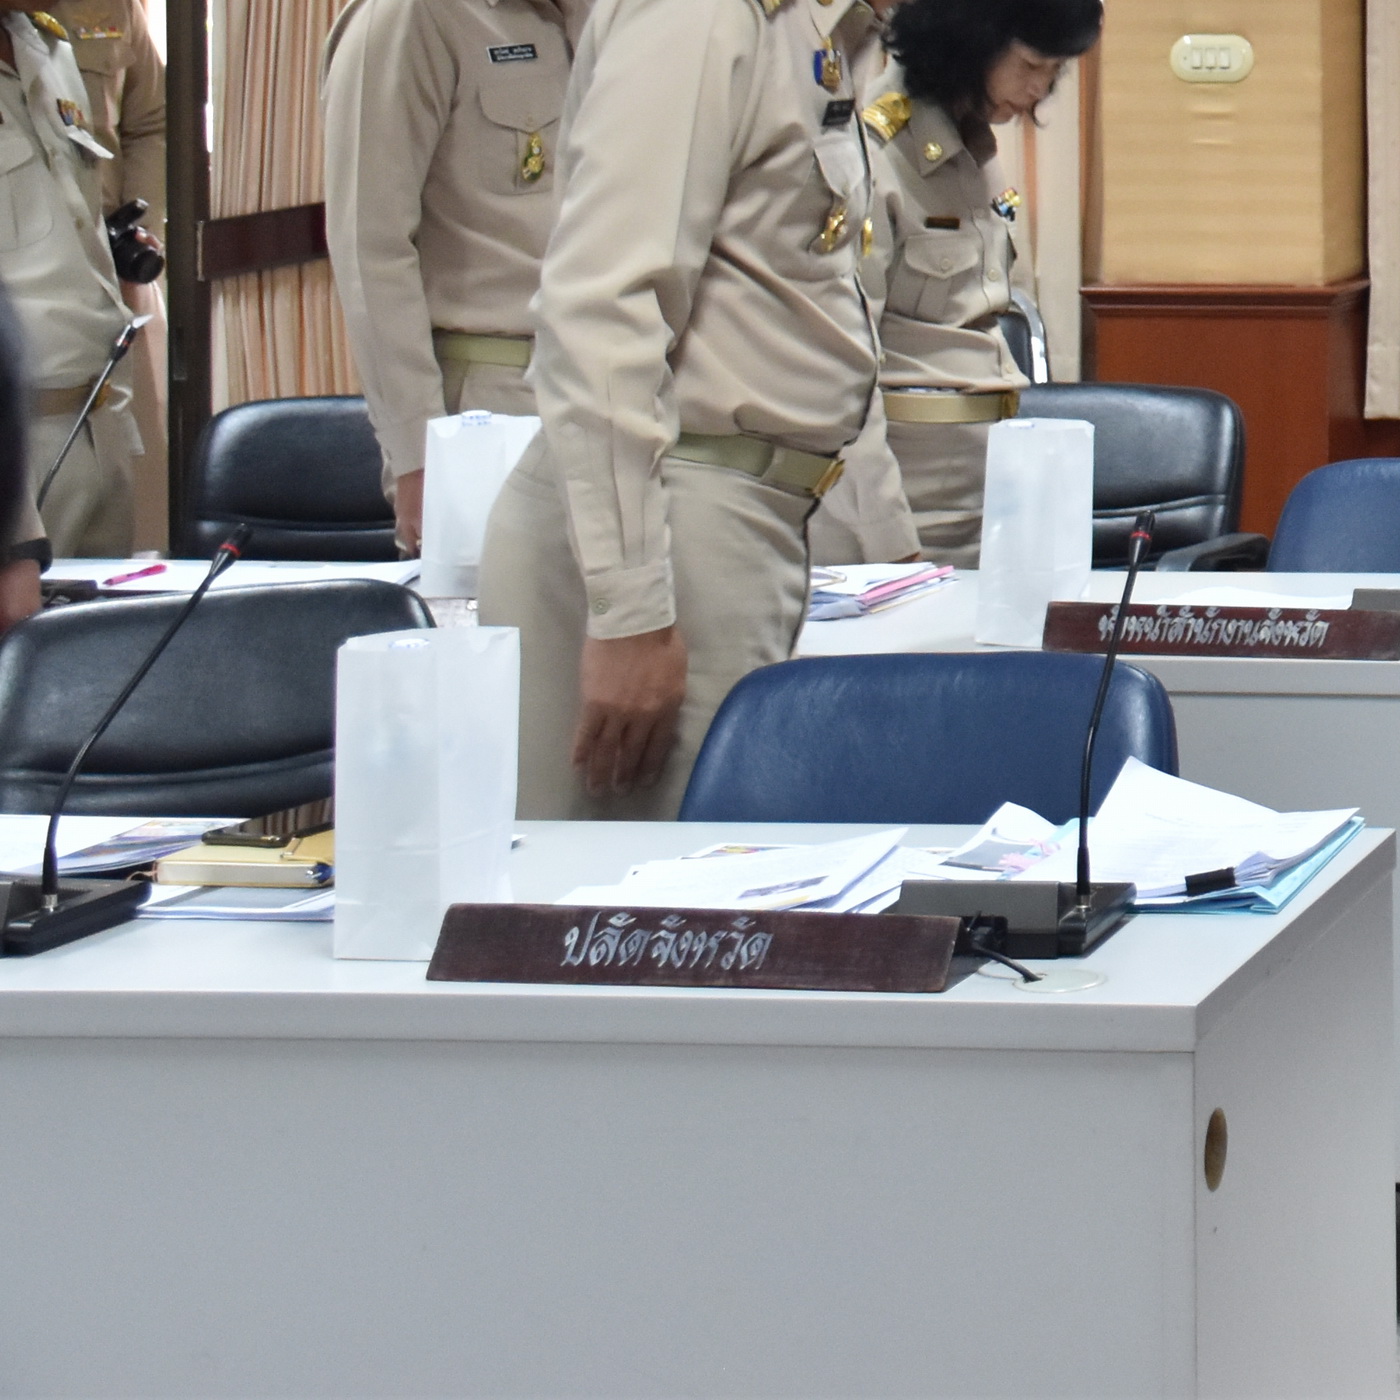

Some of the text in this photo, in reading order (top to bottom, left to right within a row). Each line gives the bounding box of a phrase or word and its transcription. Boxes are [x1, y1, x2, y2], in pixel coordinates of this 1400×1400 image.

[560, 911, 774, 971] ปลัดจังหวัด
